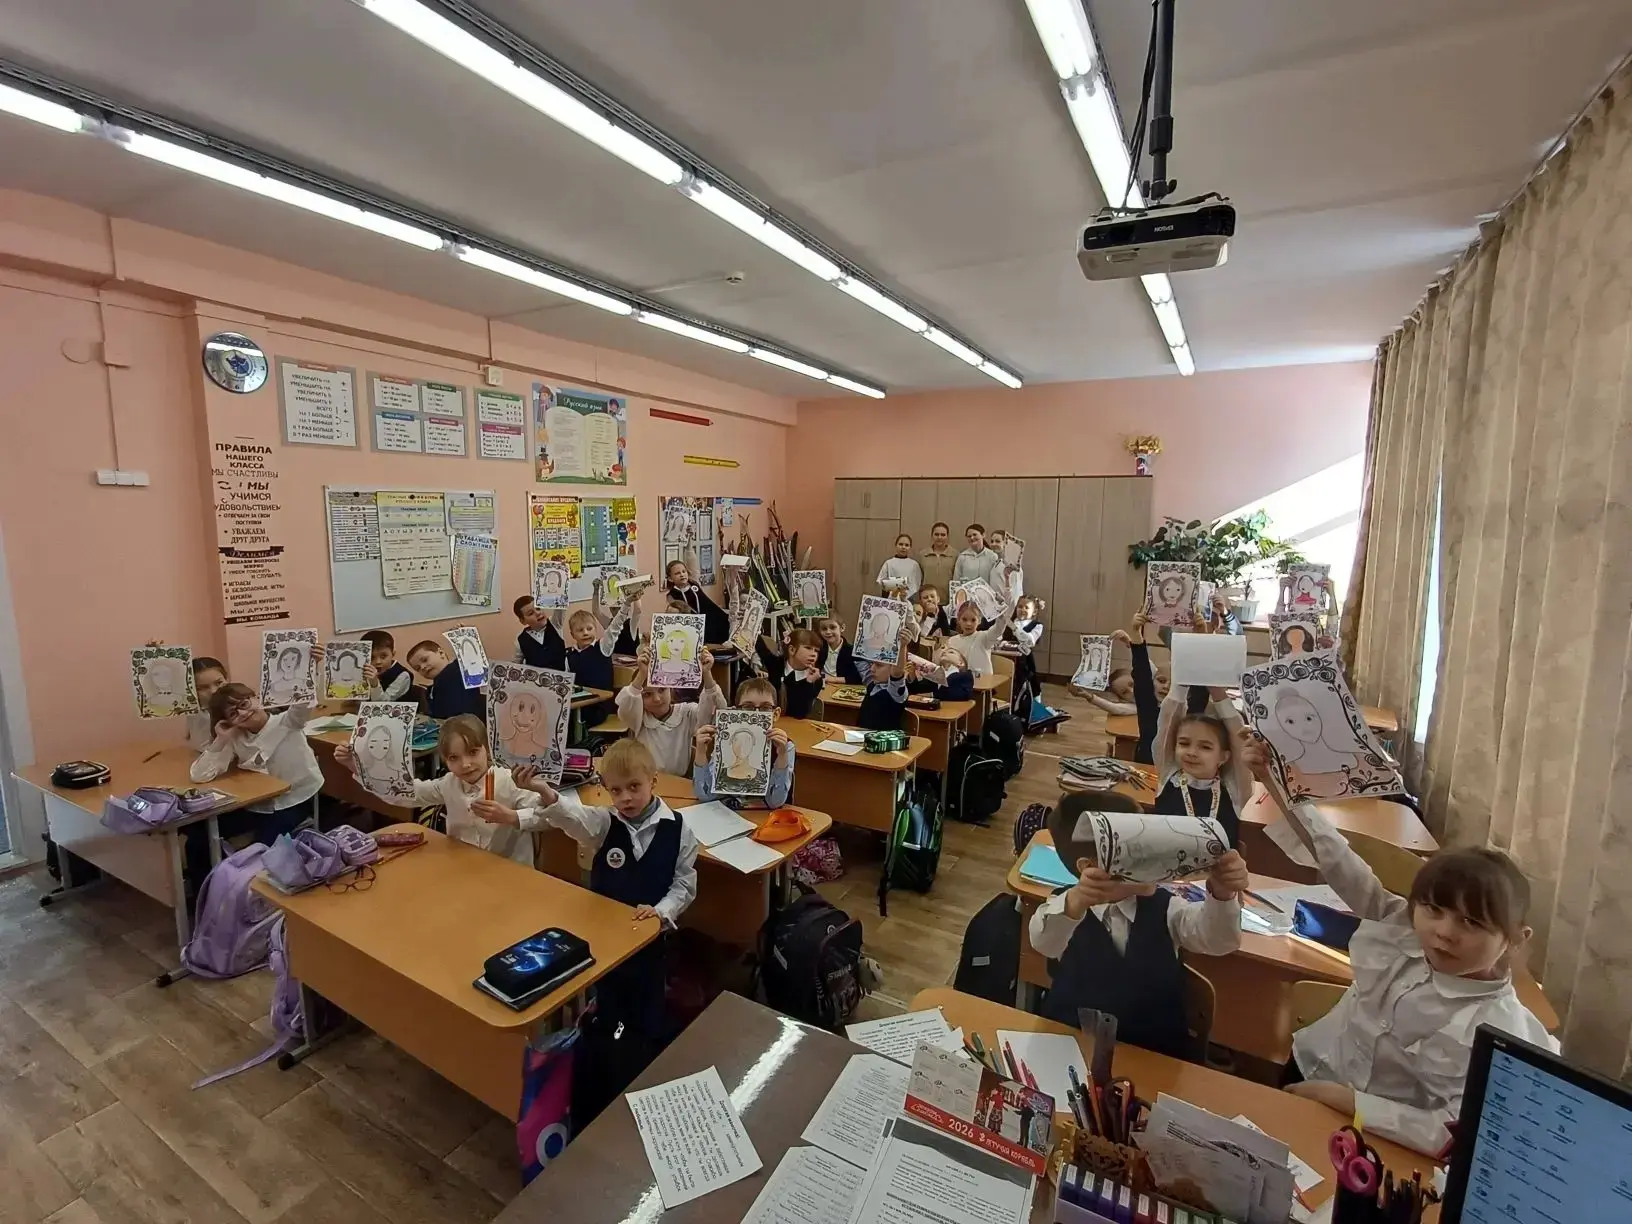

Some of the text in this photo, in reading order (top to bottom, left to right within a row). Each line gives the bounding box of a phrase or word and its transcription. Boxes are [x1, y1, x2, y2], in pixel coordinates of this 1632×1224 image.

[216, 443, 272, 454] ПРАВИЛА
[227, 469, 278, 478] СЧАСТЛИВЫ
[248, 482, 269, 490] МЫ
[948, 1118, 974, 1138] 2026
